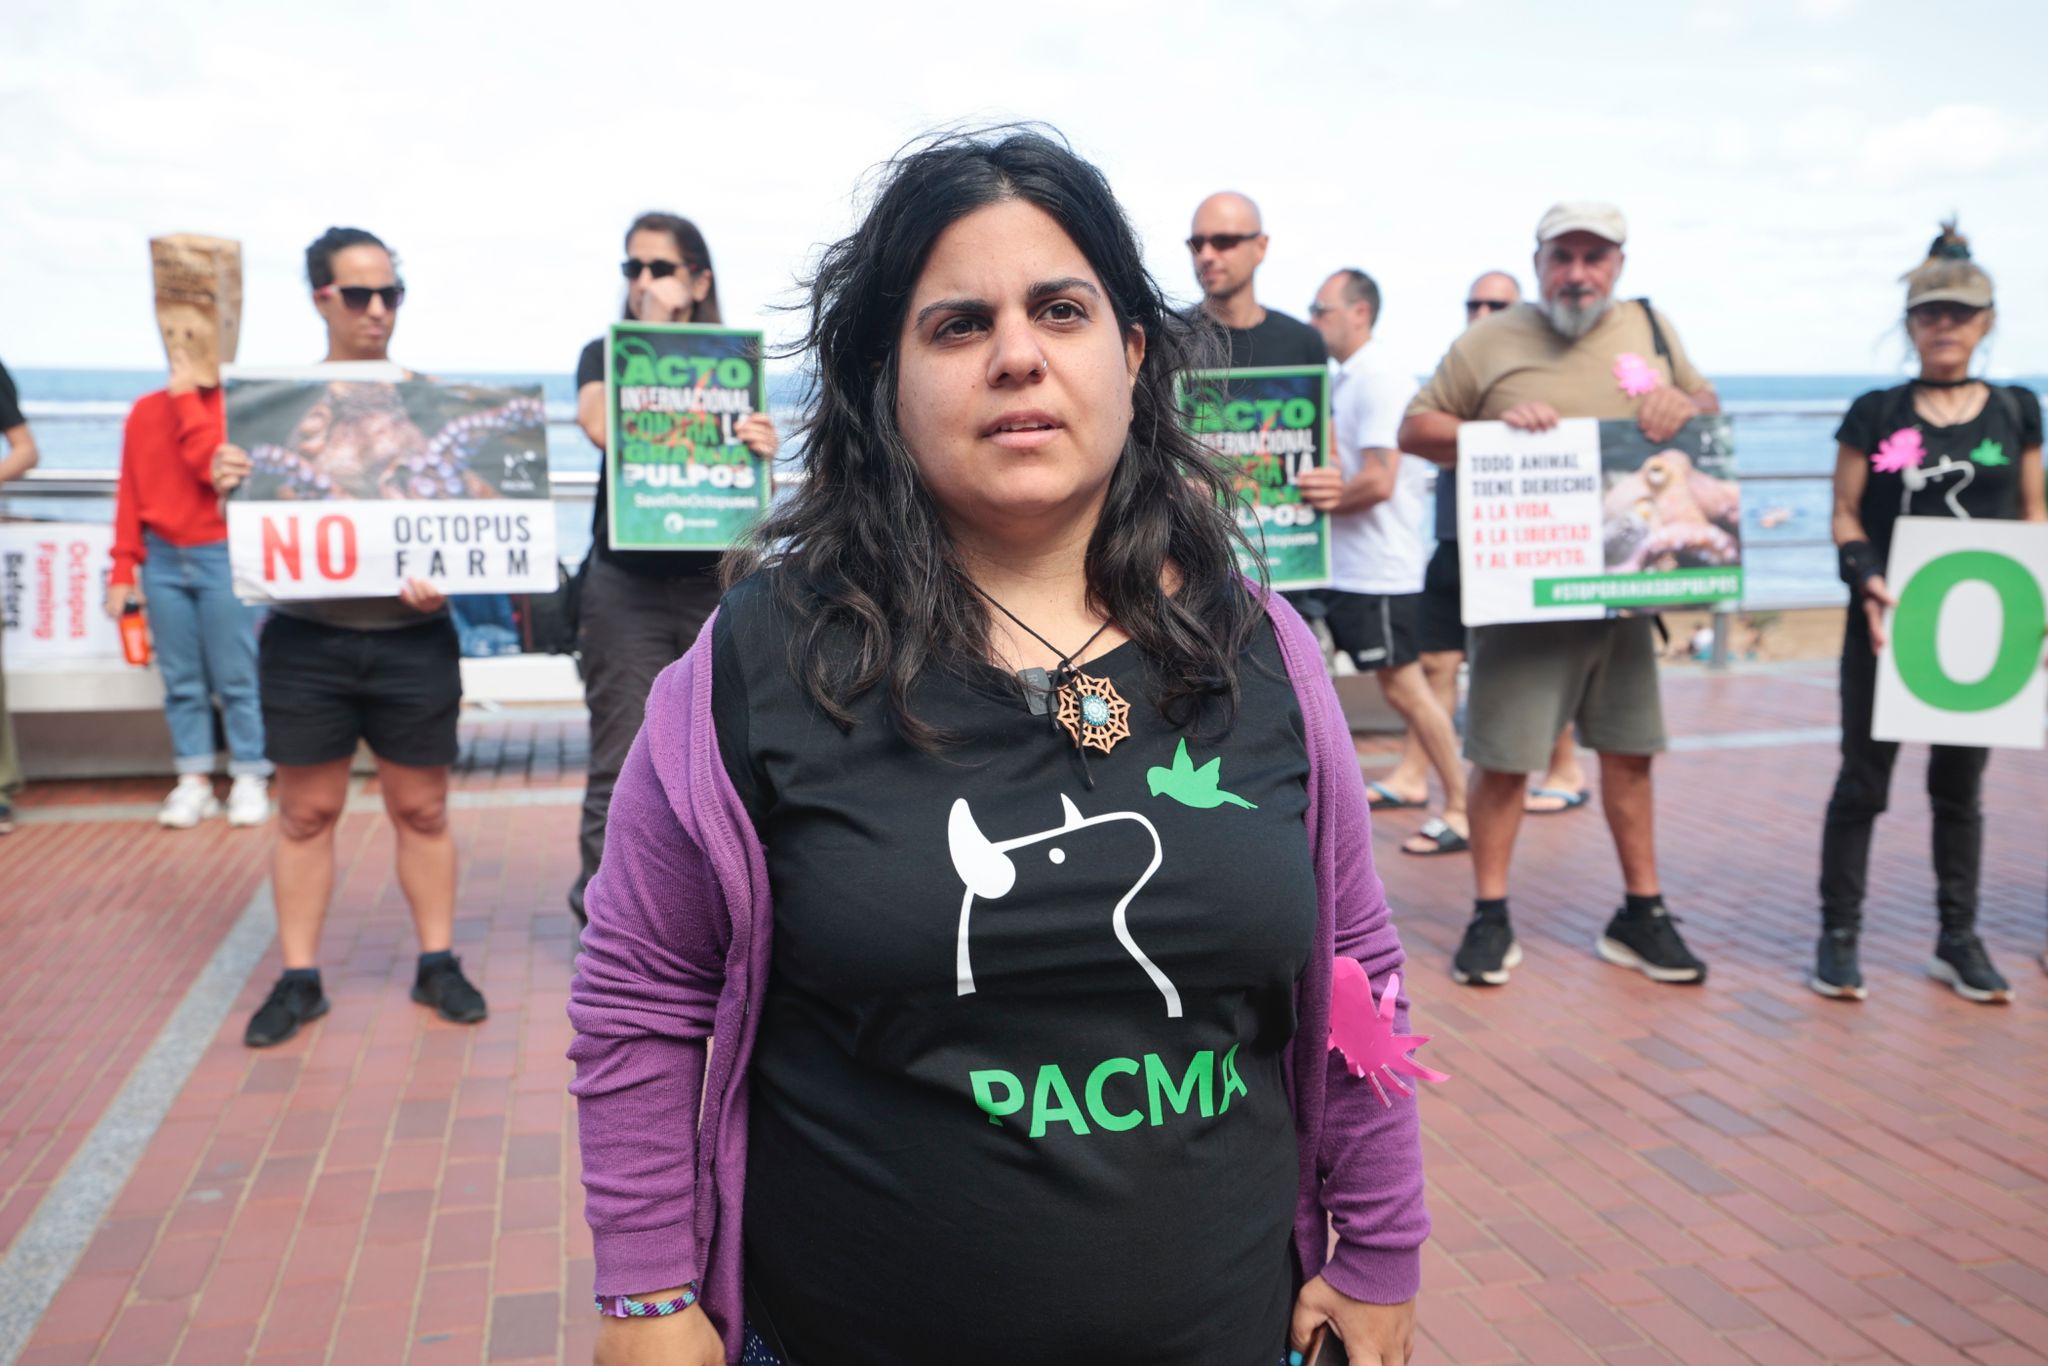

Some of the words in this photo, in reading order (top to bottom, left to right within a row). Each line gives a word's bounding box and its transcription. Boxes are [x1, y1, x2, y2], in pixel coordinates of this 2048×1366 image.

[622, 354, 753, 389] ACTO
[1192, 396, 1317, 432] ACTO
[622, 463, 755, 489] PULPOS
[1472, 455, 1514, 473] TODO
[1473, 479, 1514, 497] TIENE
[1521, 476, 1597, 496] DERECHO
[1473, 503, 1483, 521] A
[1488, 503, 1508, 521] LA
[261, 514, 359, 582] NO
[394, 514, 532, 544] OCTOPUS
[1474, 527, 1484, 545] A
[1489, 526, 1508, 545] LA
[1514, 523, 1591, 544] LIBERTAD
[395, 549, 530, 578] FARM
[1475, 551, 1484, 570] Y
[1489, 551, 1508, 569] AL
[4, 551, 25, 629] Before
[33, 541, 58, 640] Farming
[67, 541, 90, 640] Octopus
[1892, 549, 2047, 713] O
[968, 1042, 1249, 1139] PACMA
